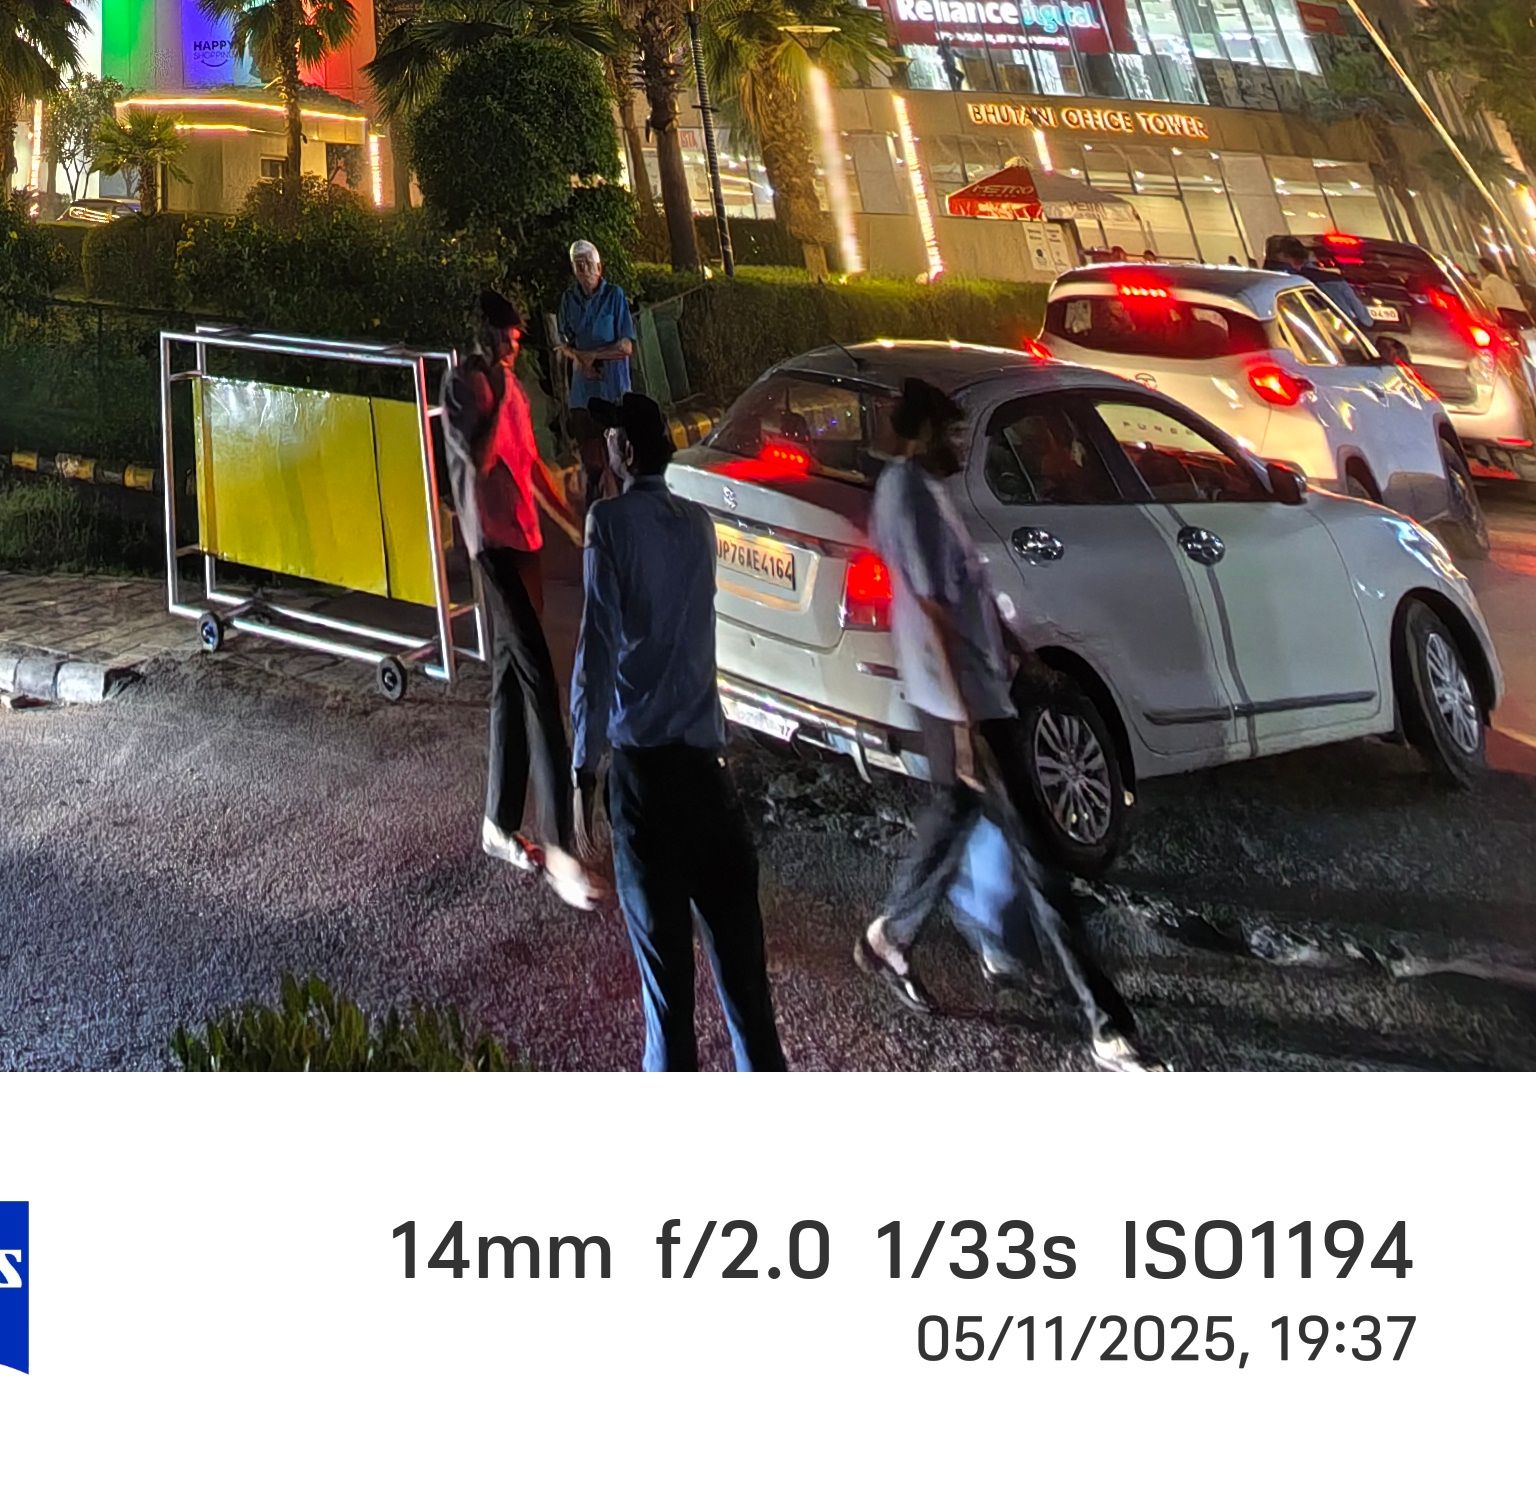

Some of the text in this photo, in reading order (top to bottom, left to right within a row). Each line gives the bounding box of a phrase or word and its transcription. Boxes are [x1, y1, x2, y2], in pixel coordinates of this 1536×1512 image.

[967, 103, 1208, 140] BHUTANI OFFICE TOWER
